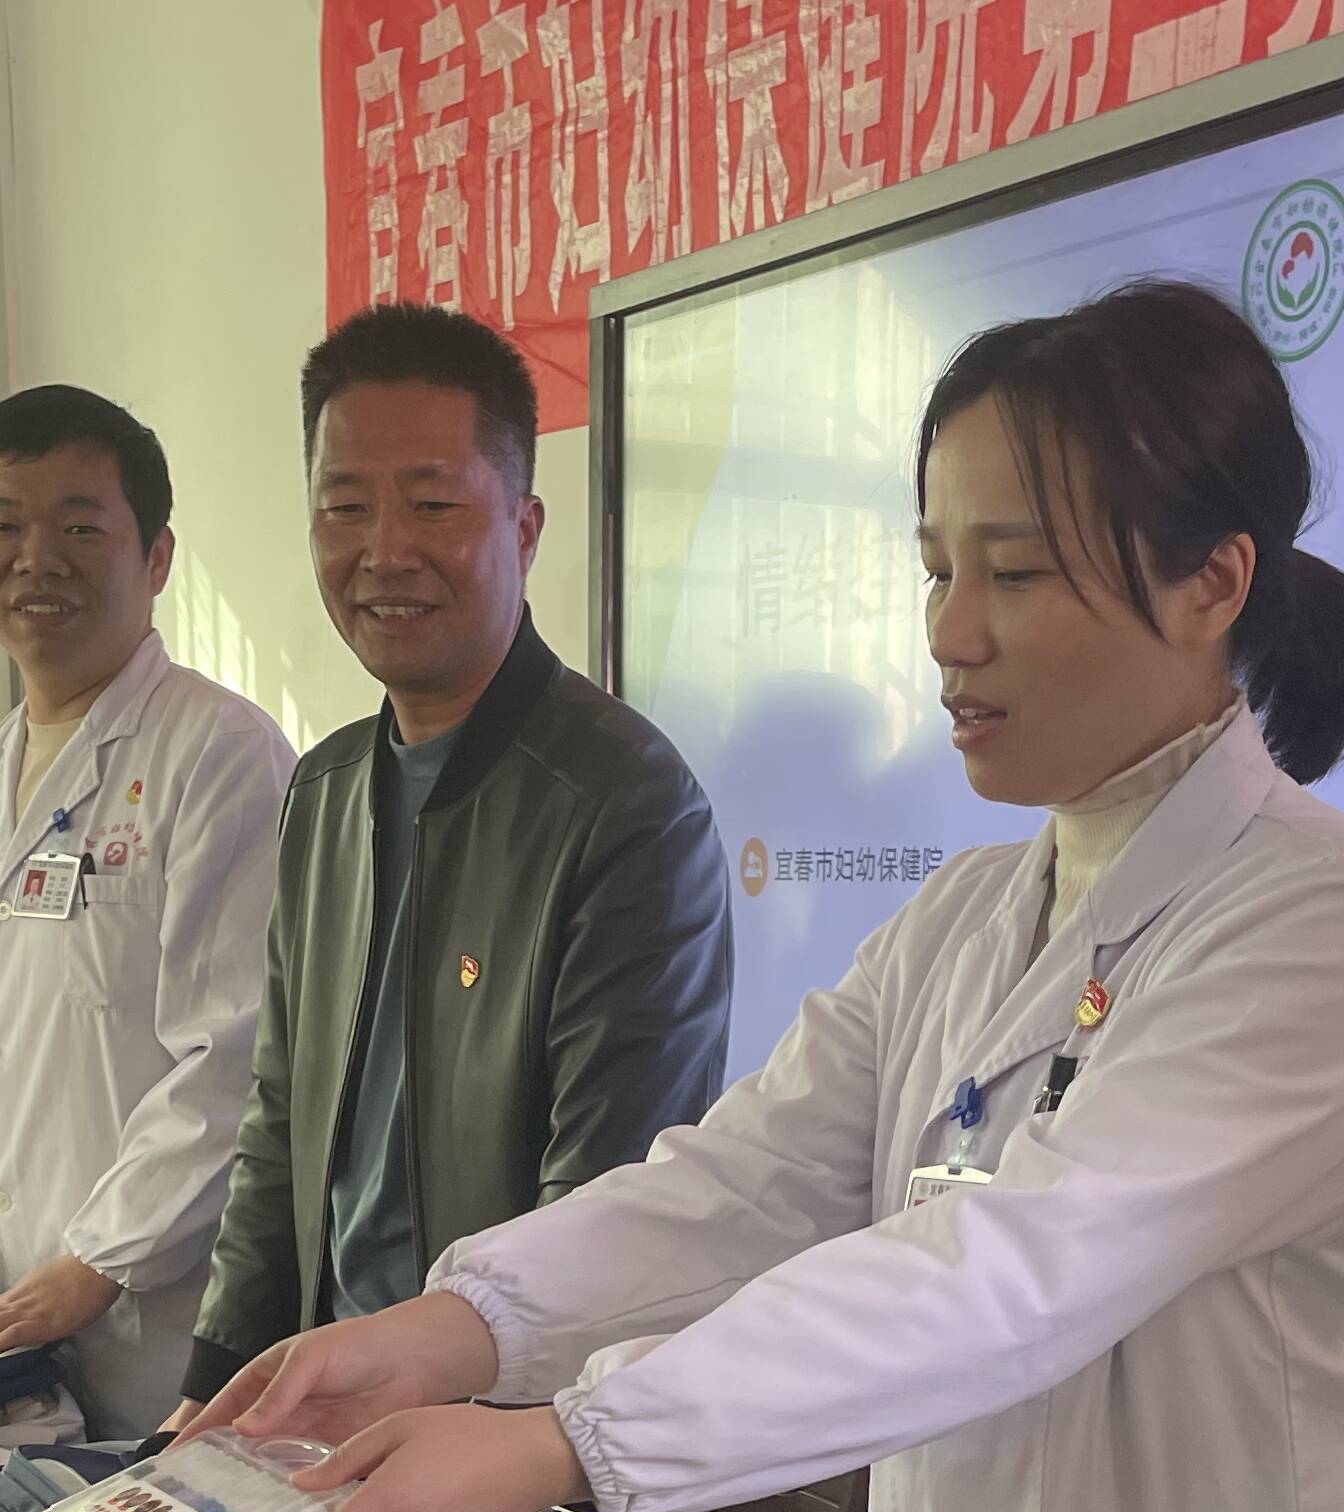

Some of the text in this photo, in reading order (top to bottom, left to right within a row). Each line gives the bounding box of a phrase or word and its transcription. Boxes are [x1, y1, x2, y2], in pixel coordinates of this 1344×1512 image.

[774, 844, 944, 883] 宜春市妇幼保健院
